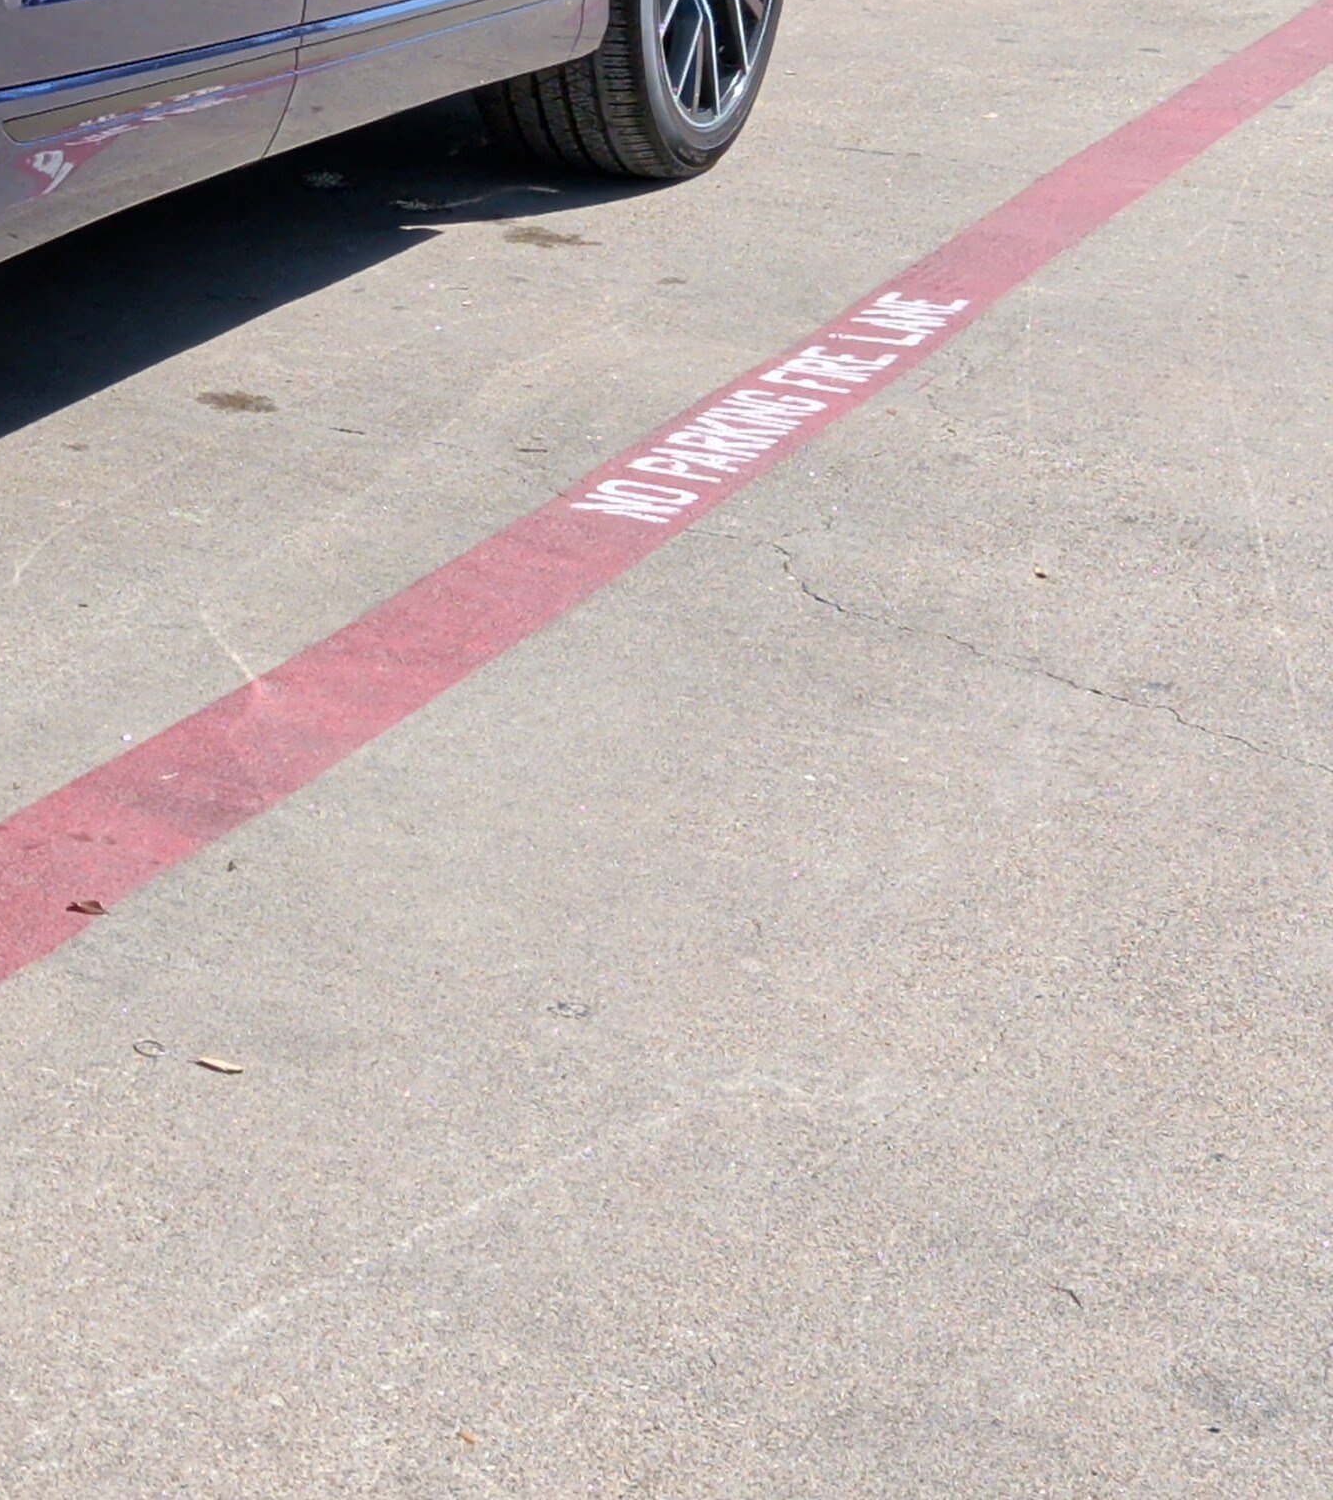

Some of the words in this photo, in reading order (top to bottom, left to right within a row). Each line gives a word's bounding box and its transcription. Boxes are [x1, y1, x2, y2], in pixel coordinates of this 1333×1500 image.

[828, 291, 970, 347] LANE
[759, 345, 898, 394] FIRE
[626, 389, 827, 484] PARKING
[570, 479, 699, 524] NO
